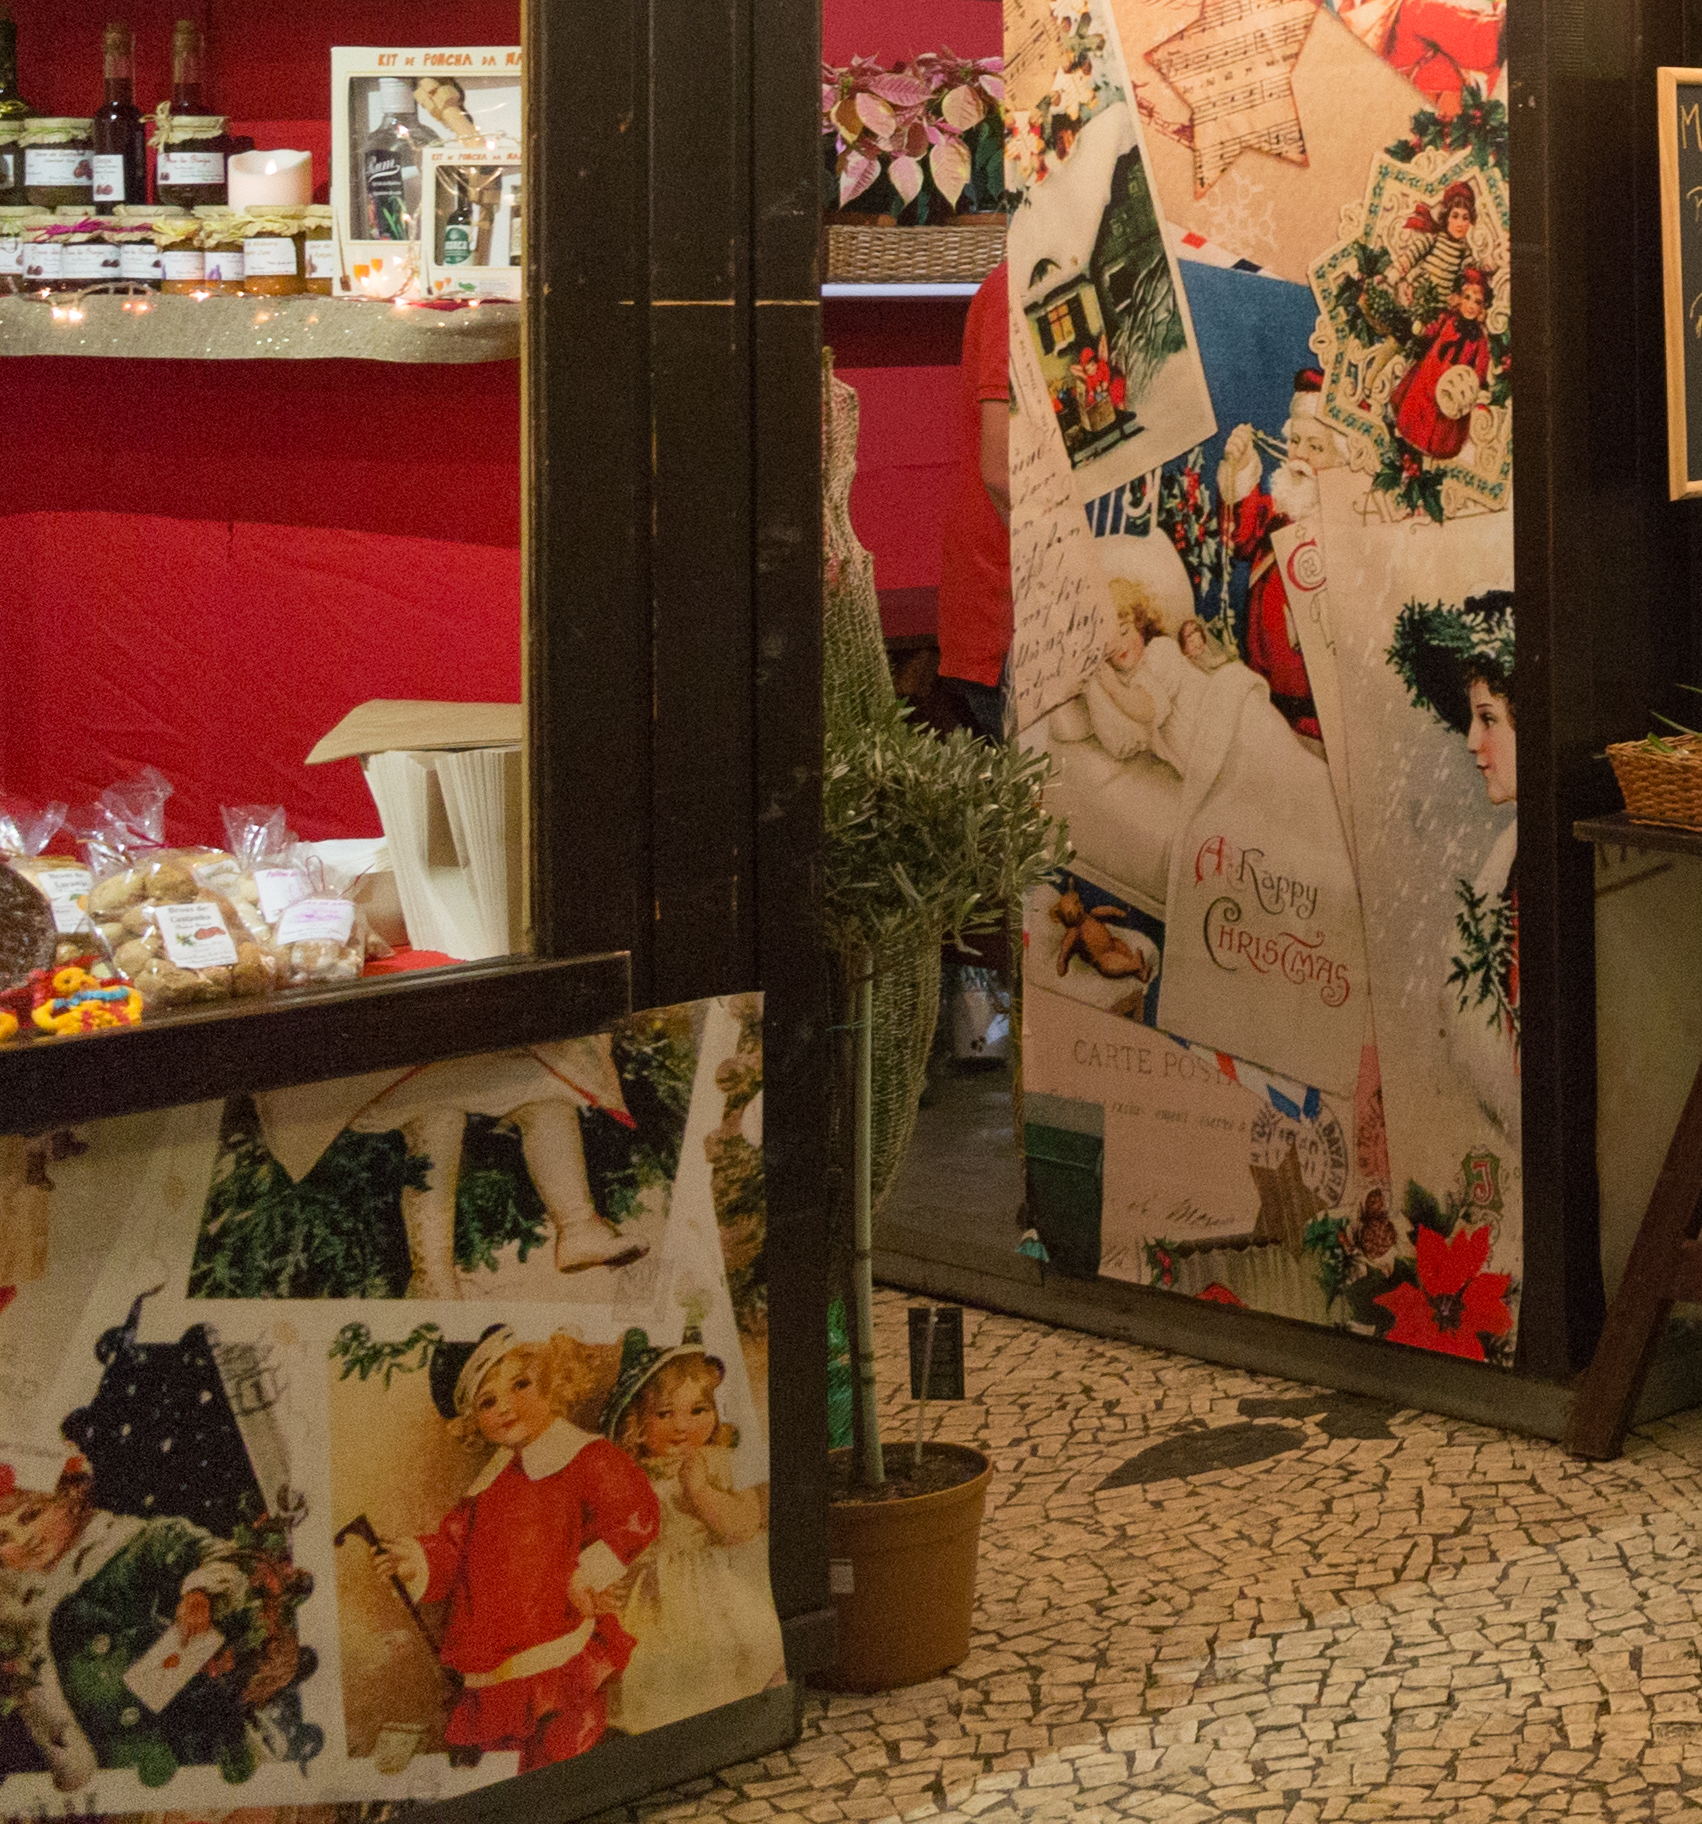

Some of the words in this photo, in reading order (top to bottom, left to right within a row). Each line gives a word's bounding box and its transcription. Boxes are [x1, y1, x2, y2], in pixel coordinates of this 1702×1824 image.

[378, 54, 398, 66] KIT
[423, 53, 472, 66] PONCHA
[482, 56, 496, 66] DA
[1195, 835, 1226, 889] A
[1203, 896, 1351, 1008] CHRISTMAS
[1072, 1039, 1153, 1076] CARTE
